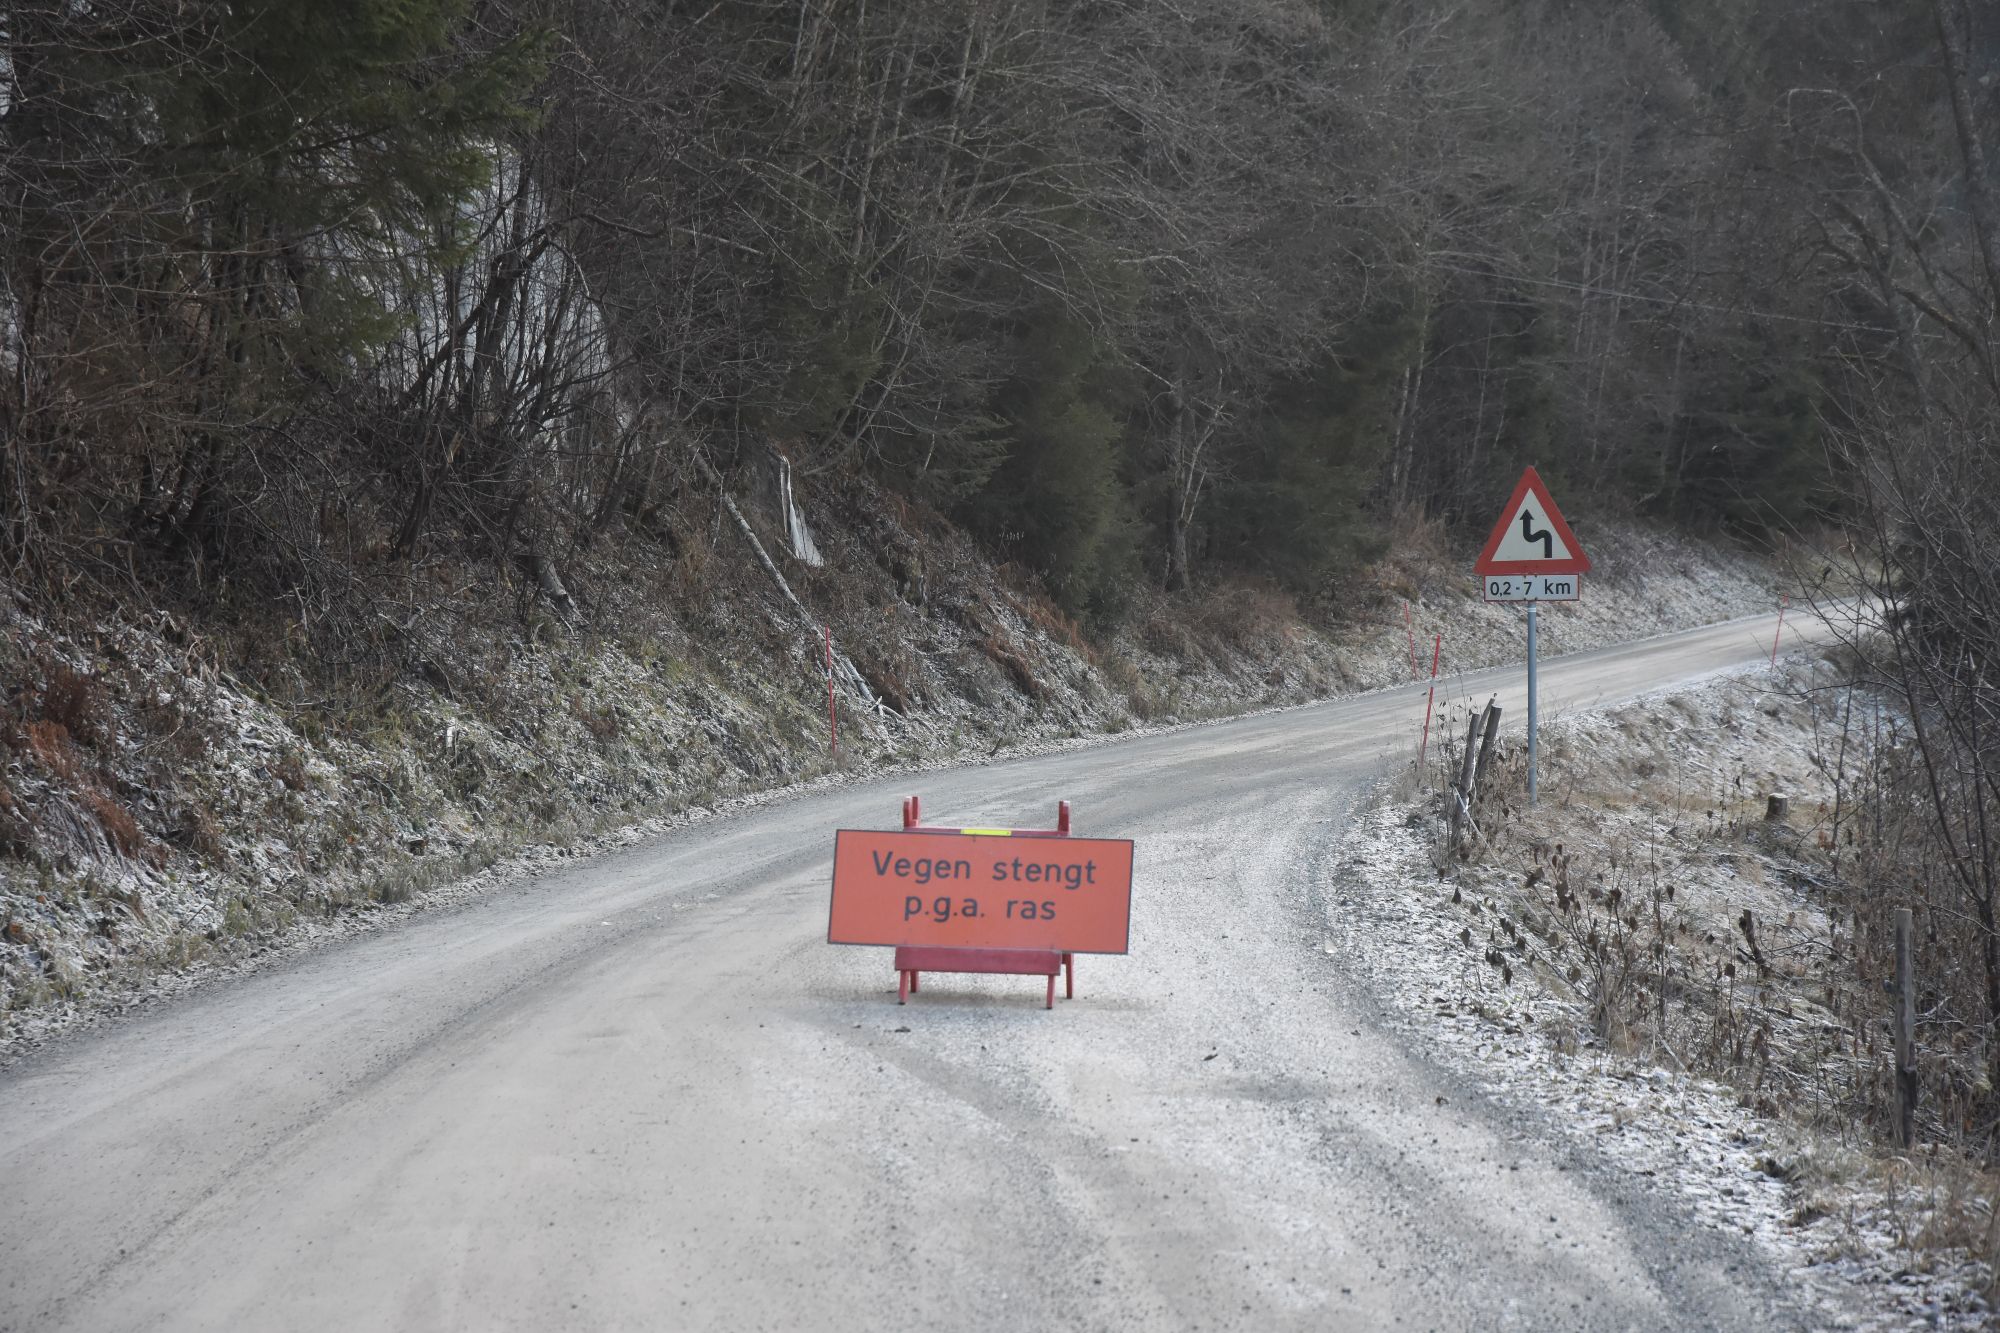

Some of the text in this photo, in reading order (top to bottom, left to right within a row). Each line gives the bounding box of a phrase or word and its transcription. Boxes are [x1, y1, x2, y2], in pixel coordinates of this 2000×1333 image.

[1544, 579, 1571, 595] km
[872, 850, 1097, 890] Vegen stengt
[904, 895, 1057, 923] p.g.a. ras
